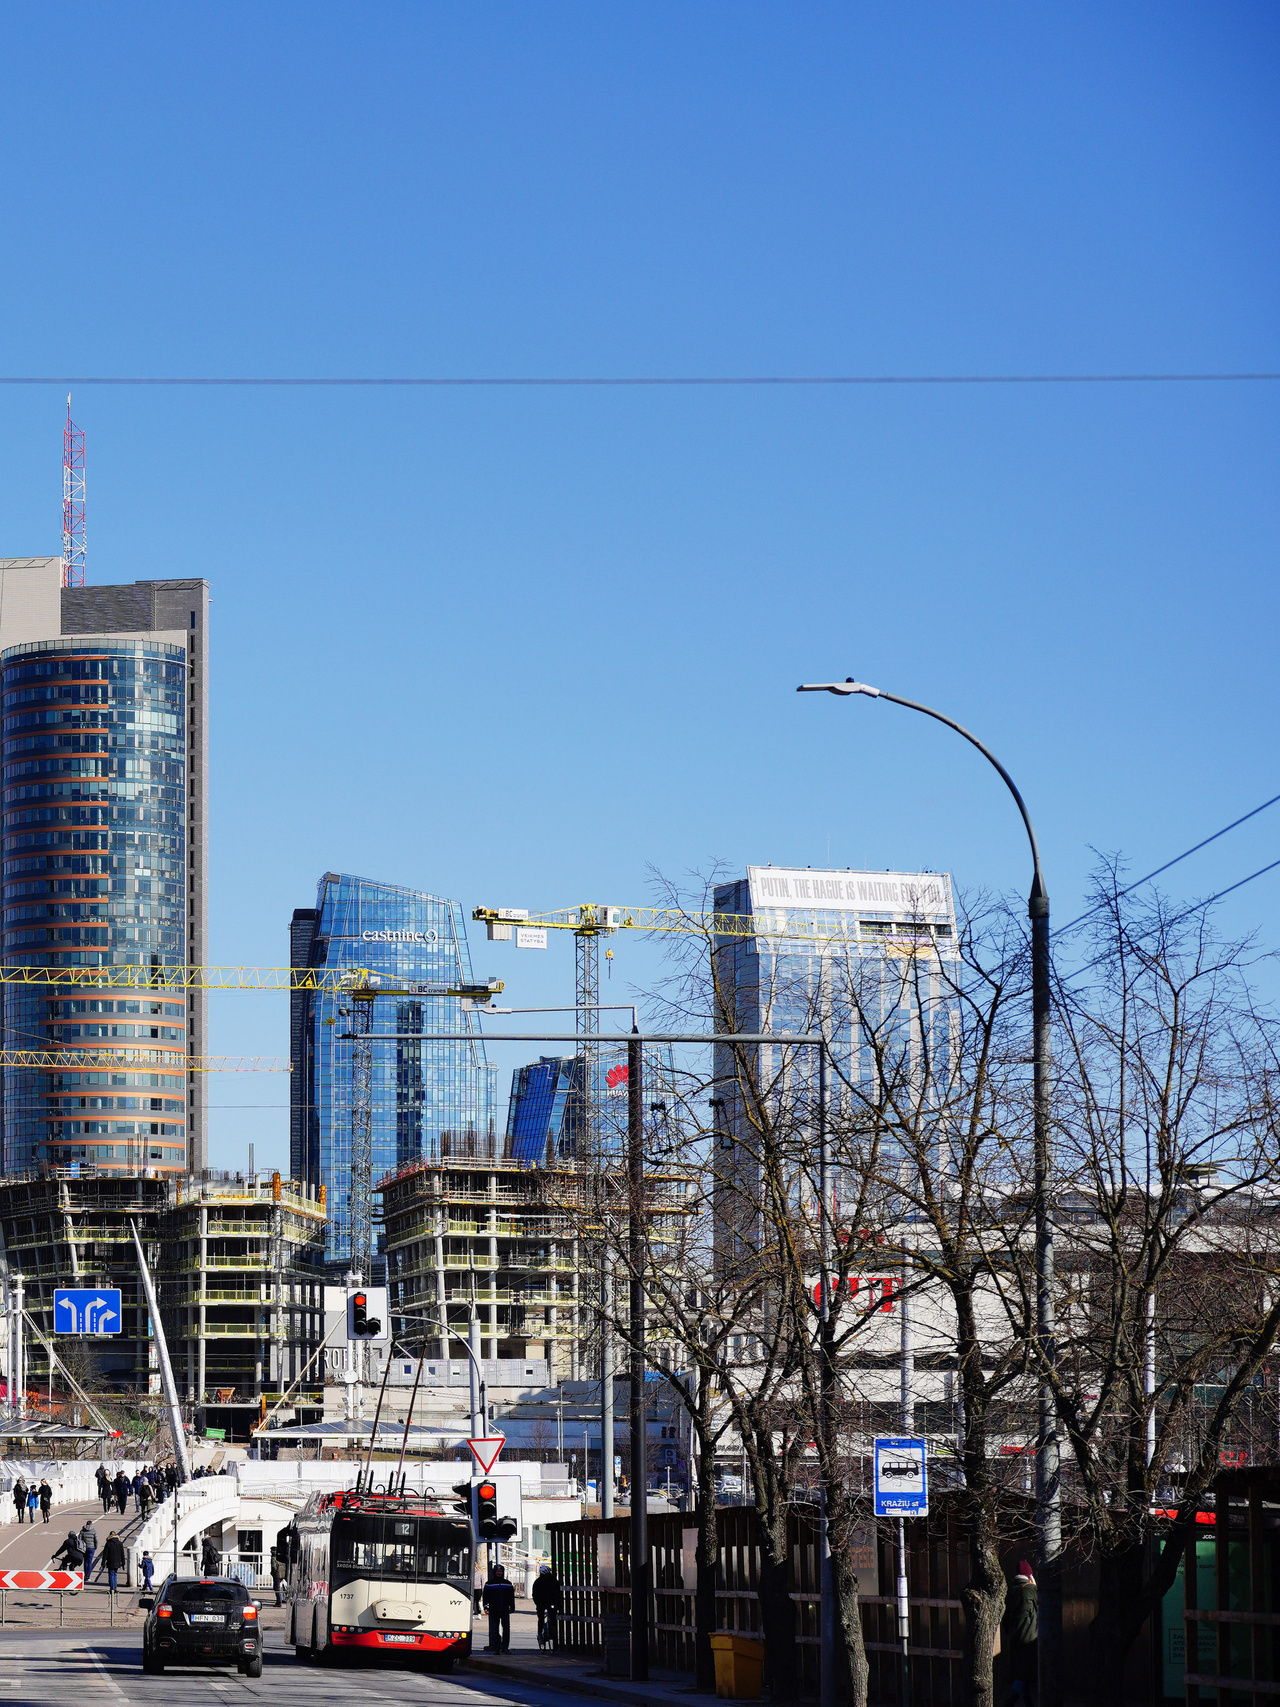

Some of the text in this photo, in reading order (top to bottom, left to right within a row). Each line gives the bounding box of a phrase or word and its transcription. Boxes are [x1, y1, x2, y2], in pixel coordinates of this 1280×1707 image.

[760, 877, 792, 899] PUTIN,
[793, 879, 811, 898] THE
[812, 879, 844, 899] HAGUE
[845, 880, 855, 900] IS
[856, 881, 898, 901] WAITING
[900, 882, 918, 902] FOR
[362, 929, 423, 942] eastnine
[607, 1089, 629, 1097] HUAW
[401, 1524, 410, 1535] 12
